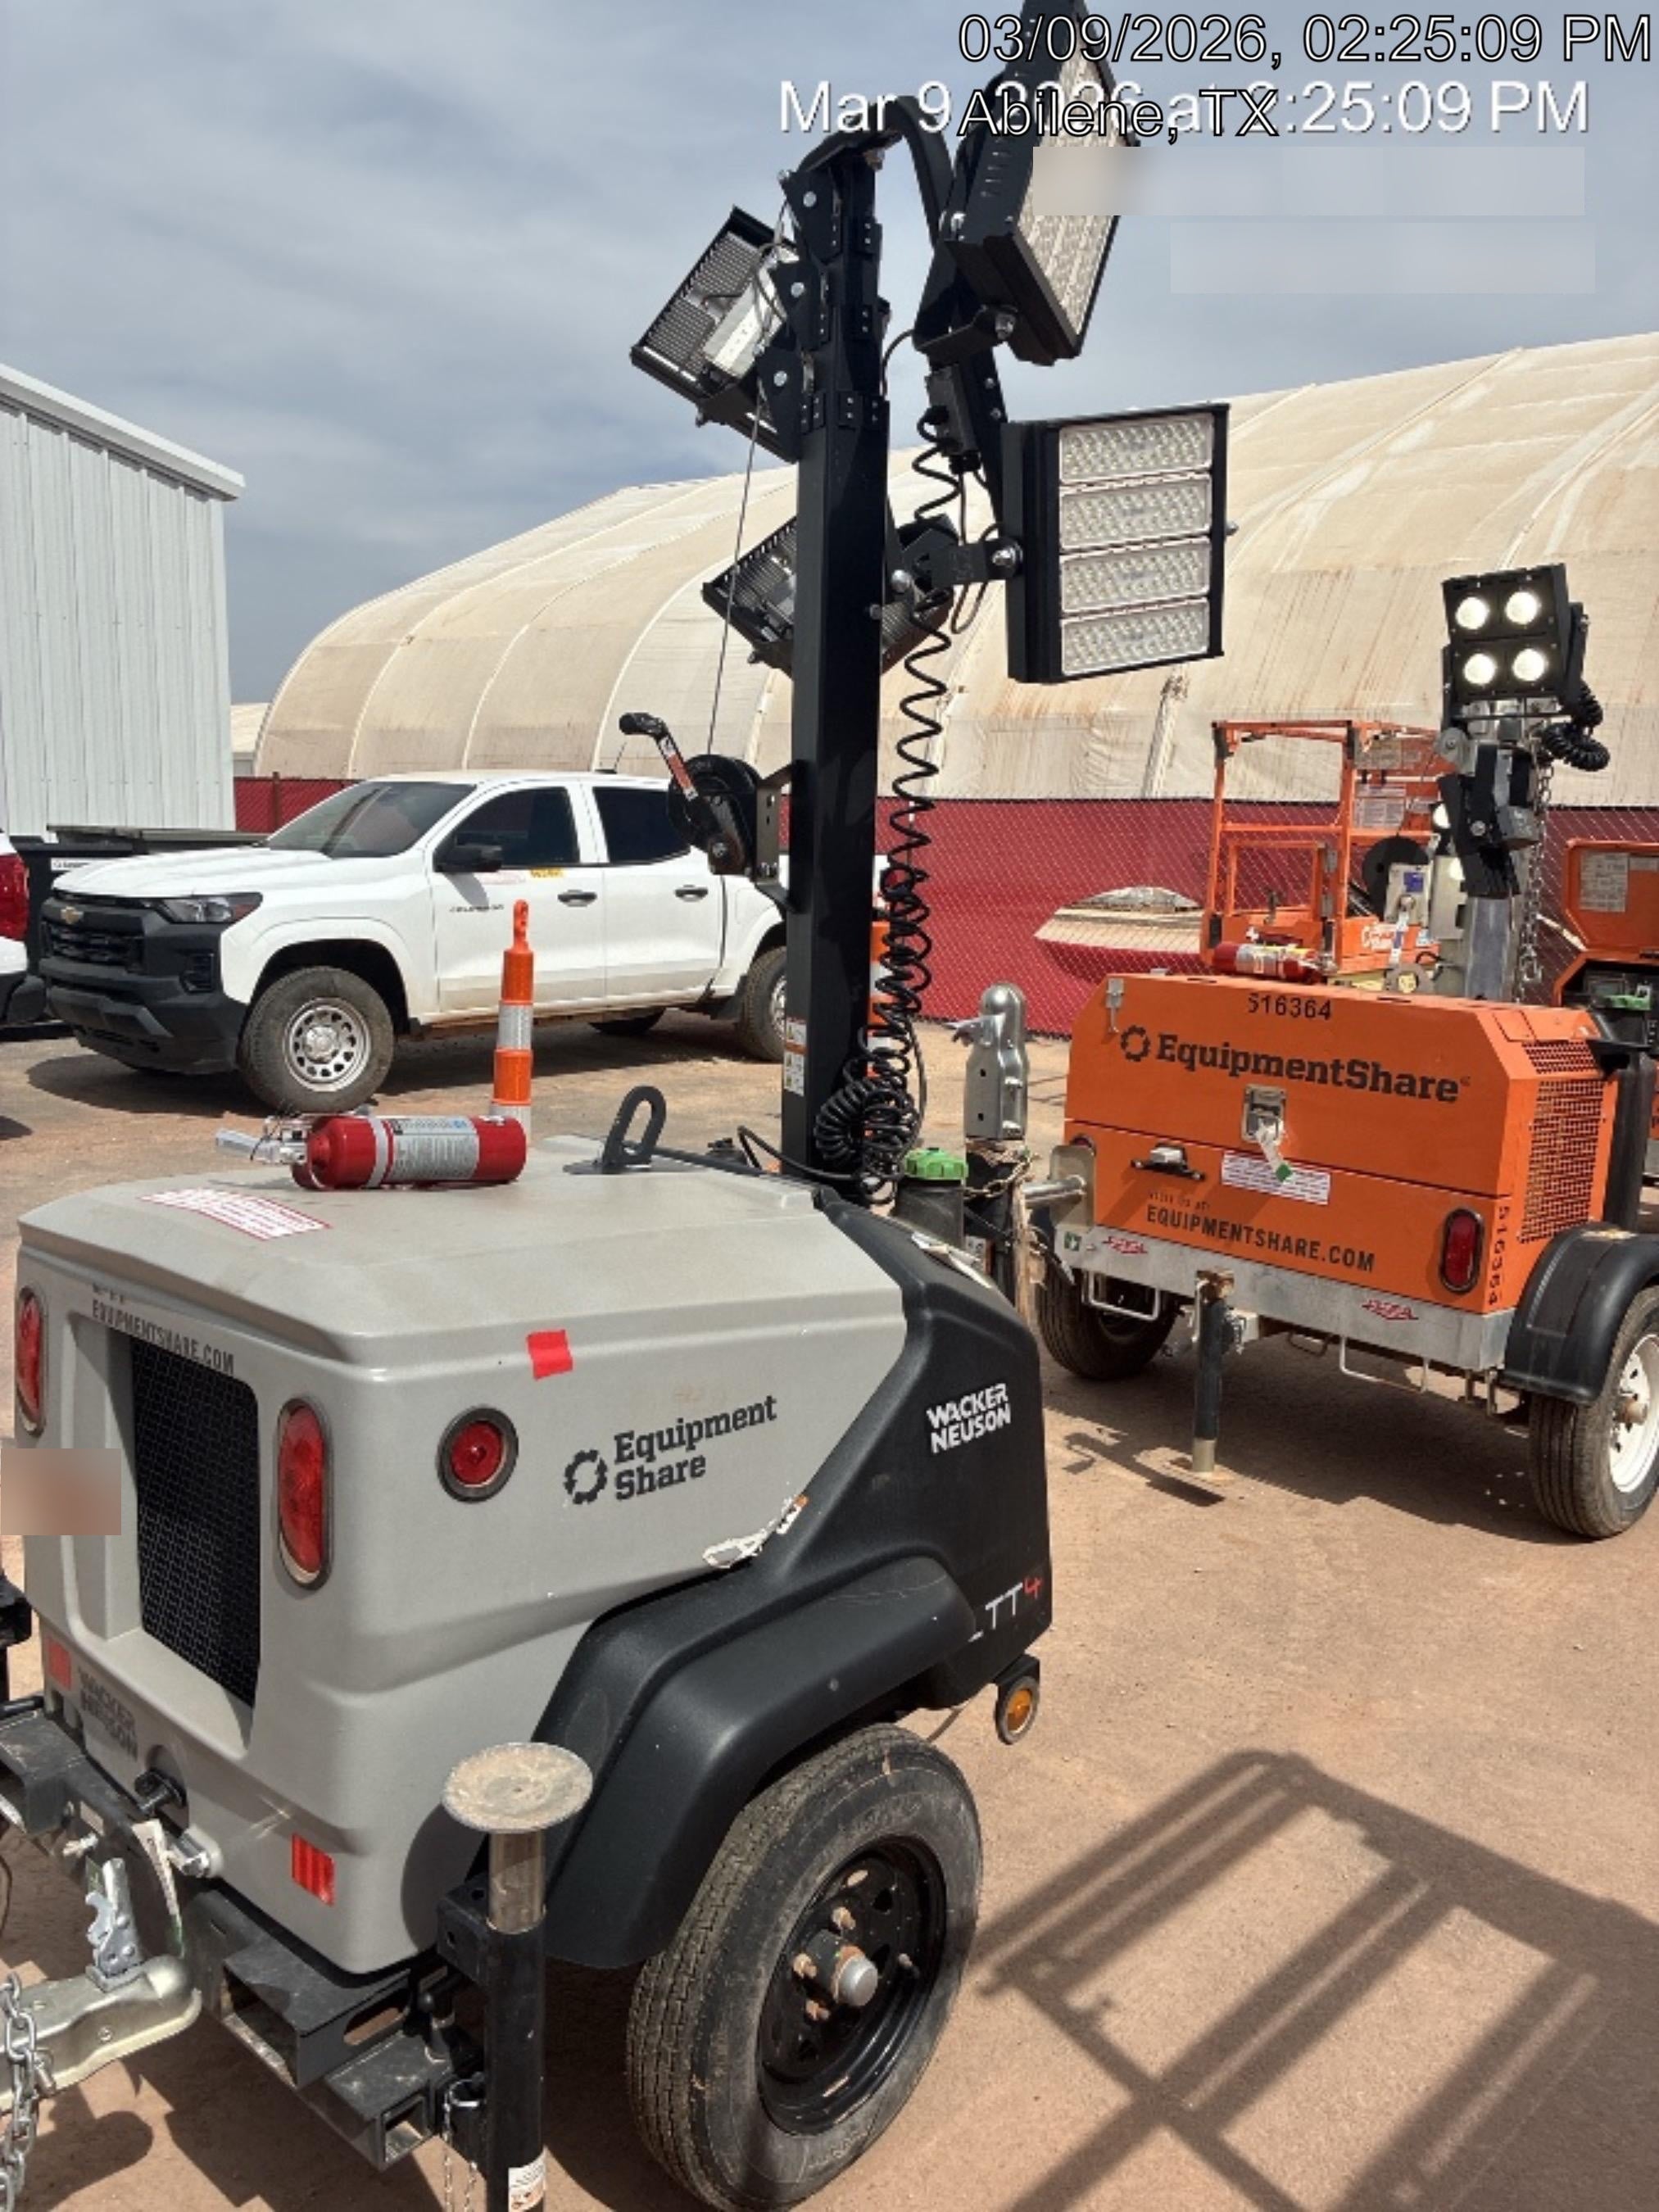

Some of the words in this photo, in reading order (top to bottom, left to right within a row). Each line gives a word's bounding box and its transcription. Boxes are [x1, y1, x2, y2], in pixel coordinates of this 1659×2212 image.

[1247, 991, 1333, 1021] 516364
[1157, 1032, 1460, 1103] EquipmentShare
[1147, 1204, 1376, 1271] EQUIPMENTSHARE.COM
[613, 1395, 777, 1466] Equipment
[926, 1383, 1009, 1430] WACKER
[930, 1403, 1011, 1454] NEUSON
[614, 1454, 707, 1501] Share
